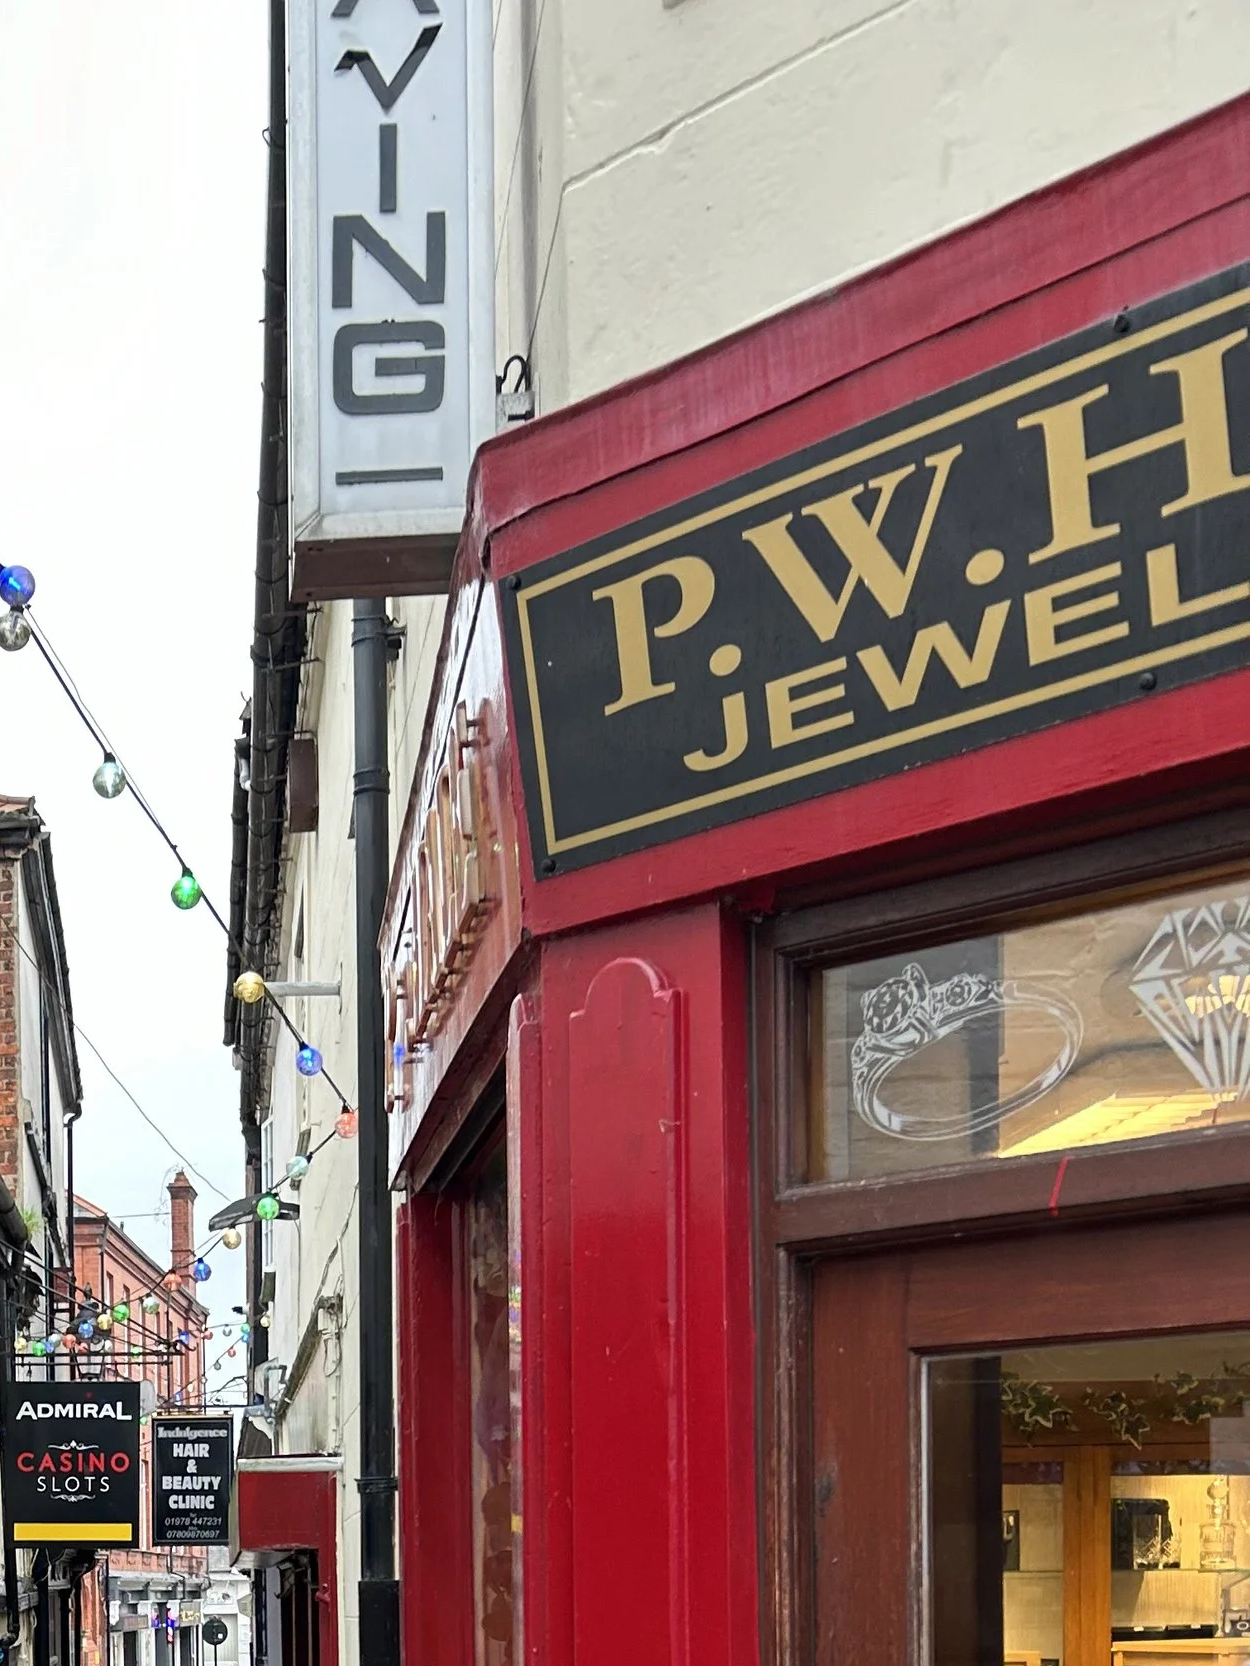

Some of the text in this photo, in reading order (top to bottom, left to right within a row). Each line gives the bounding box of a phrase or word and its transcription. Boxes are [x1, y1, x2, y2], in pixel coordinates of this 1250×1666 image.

[15, 1401, 133, 1420] ADMIRAL
[157, 1426, 228, 1441] Indulgence
[173, 1443, 210, 1458] HAIR
[16, 1452, 130, 1473] CASINO
[186, 1459, 197, 1473] &
[36, 1476, 110, 1492] SLOTS
[162, 1475, 222, 1490] BEAUTY
[168, 1494, 215, 1510] CLINIC
[164, 1517, 222, 1526] 01978 447231
